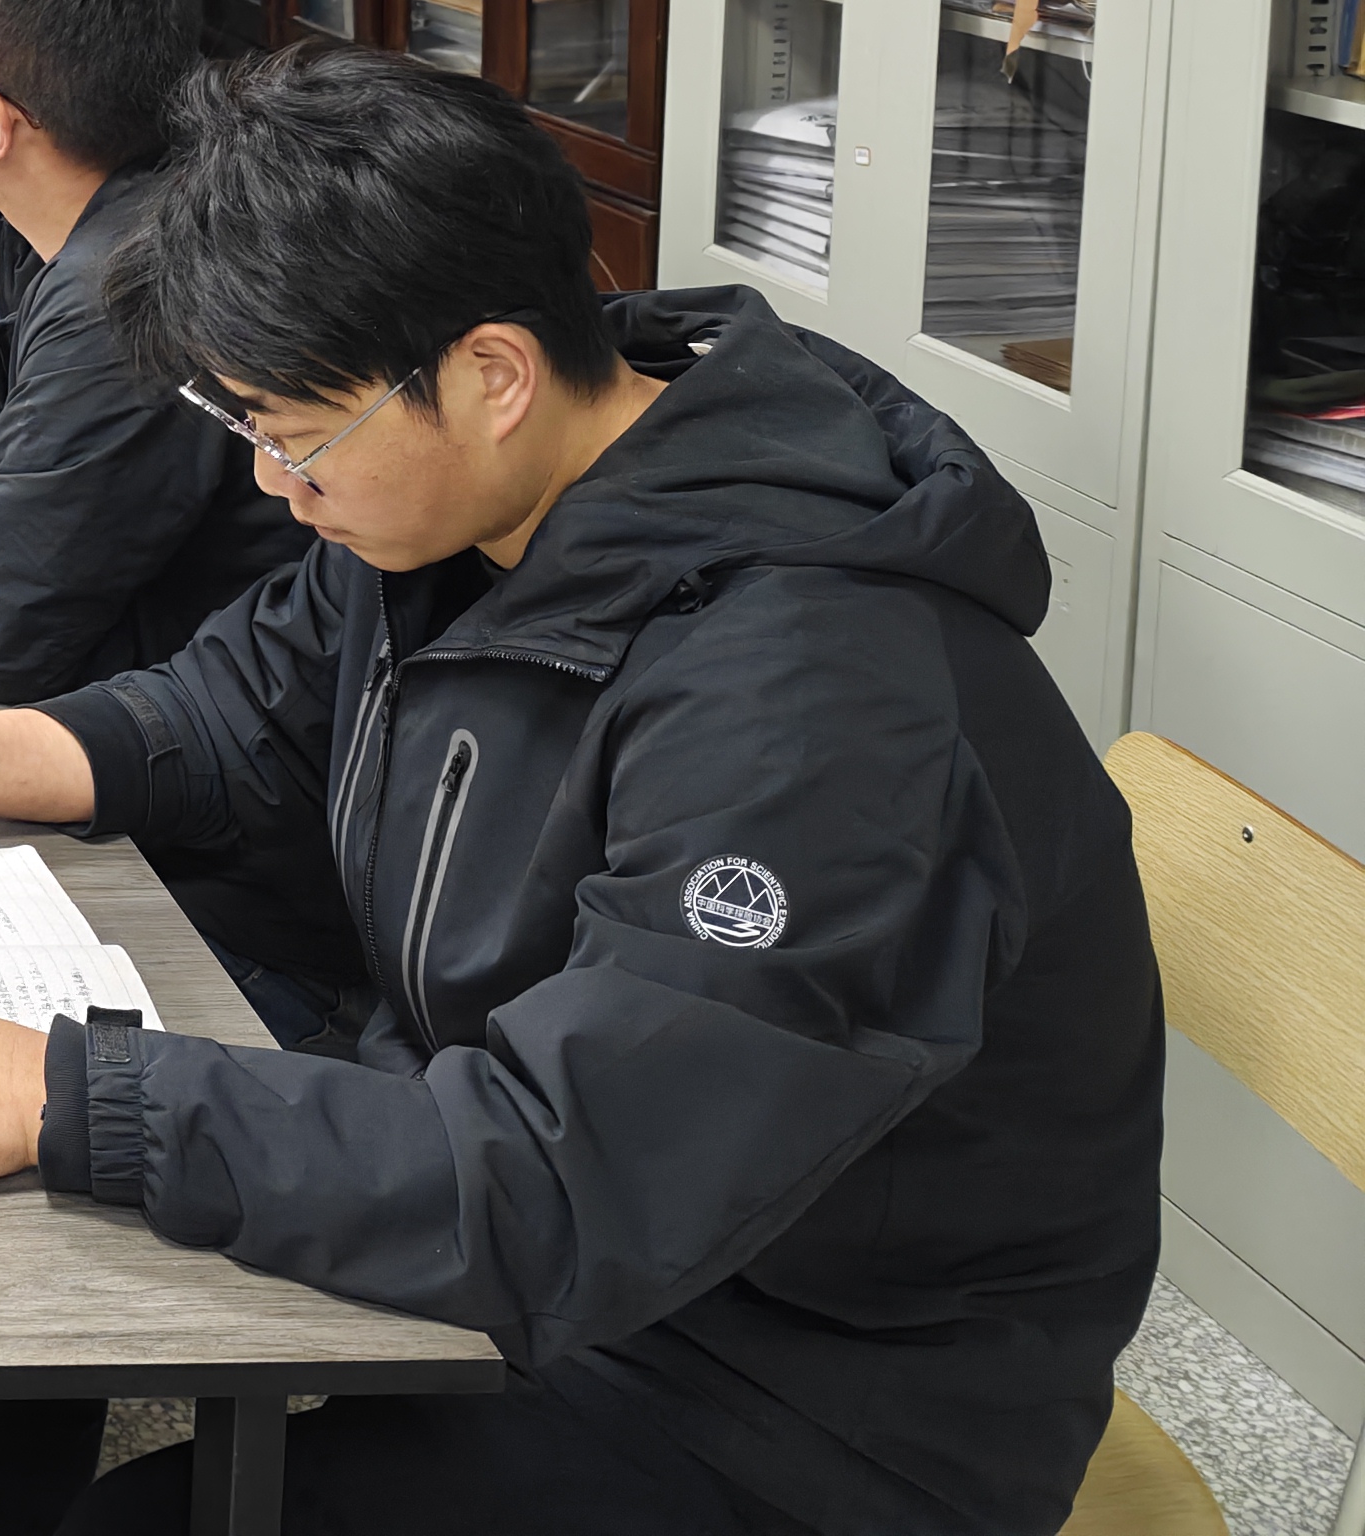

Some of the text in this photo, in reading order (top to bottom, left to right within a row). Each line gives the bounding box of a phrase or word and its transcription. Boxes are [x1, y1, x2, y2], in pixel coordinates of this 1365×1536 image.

[727, 856, 748, 866] FOR
[684, 858, 725, 909] ASSOCIATION
[750, 862, 787, 907] SCIENTIFIC
[686, 912, 709, 941] CHINA
